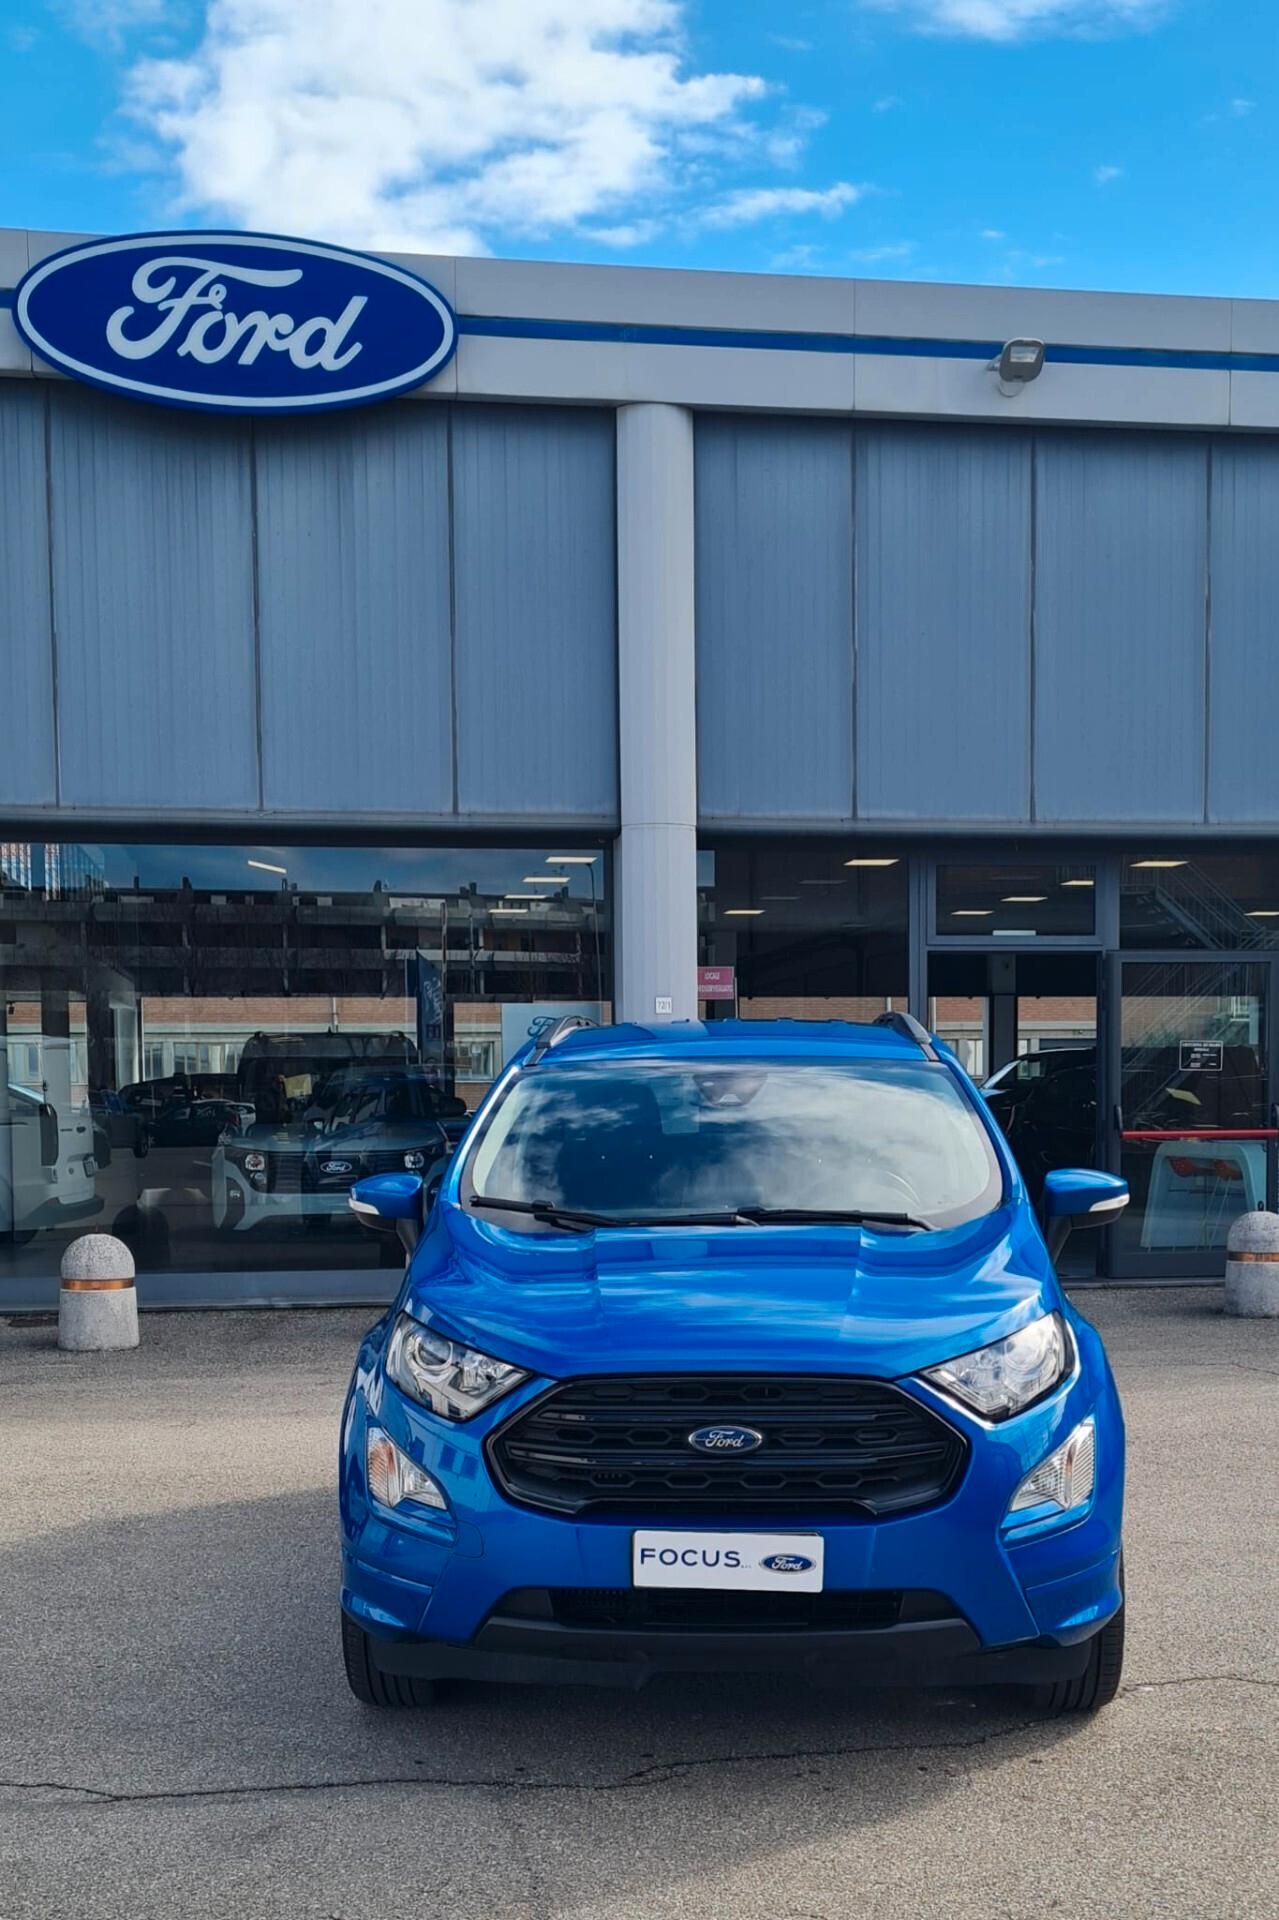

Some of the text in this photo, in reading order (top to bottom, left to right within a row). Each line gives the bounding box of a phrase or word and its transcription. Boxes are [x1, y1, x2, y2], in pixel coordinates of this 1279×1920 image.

[106, 256, 368, 371] Ford
[705, 1430, 744, 1447] Ford
[640, 1548, 803, 1571] FOCUS Ford
